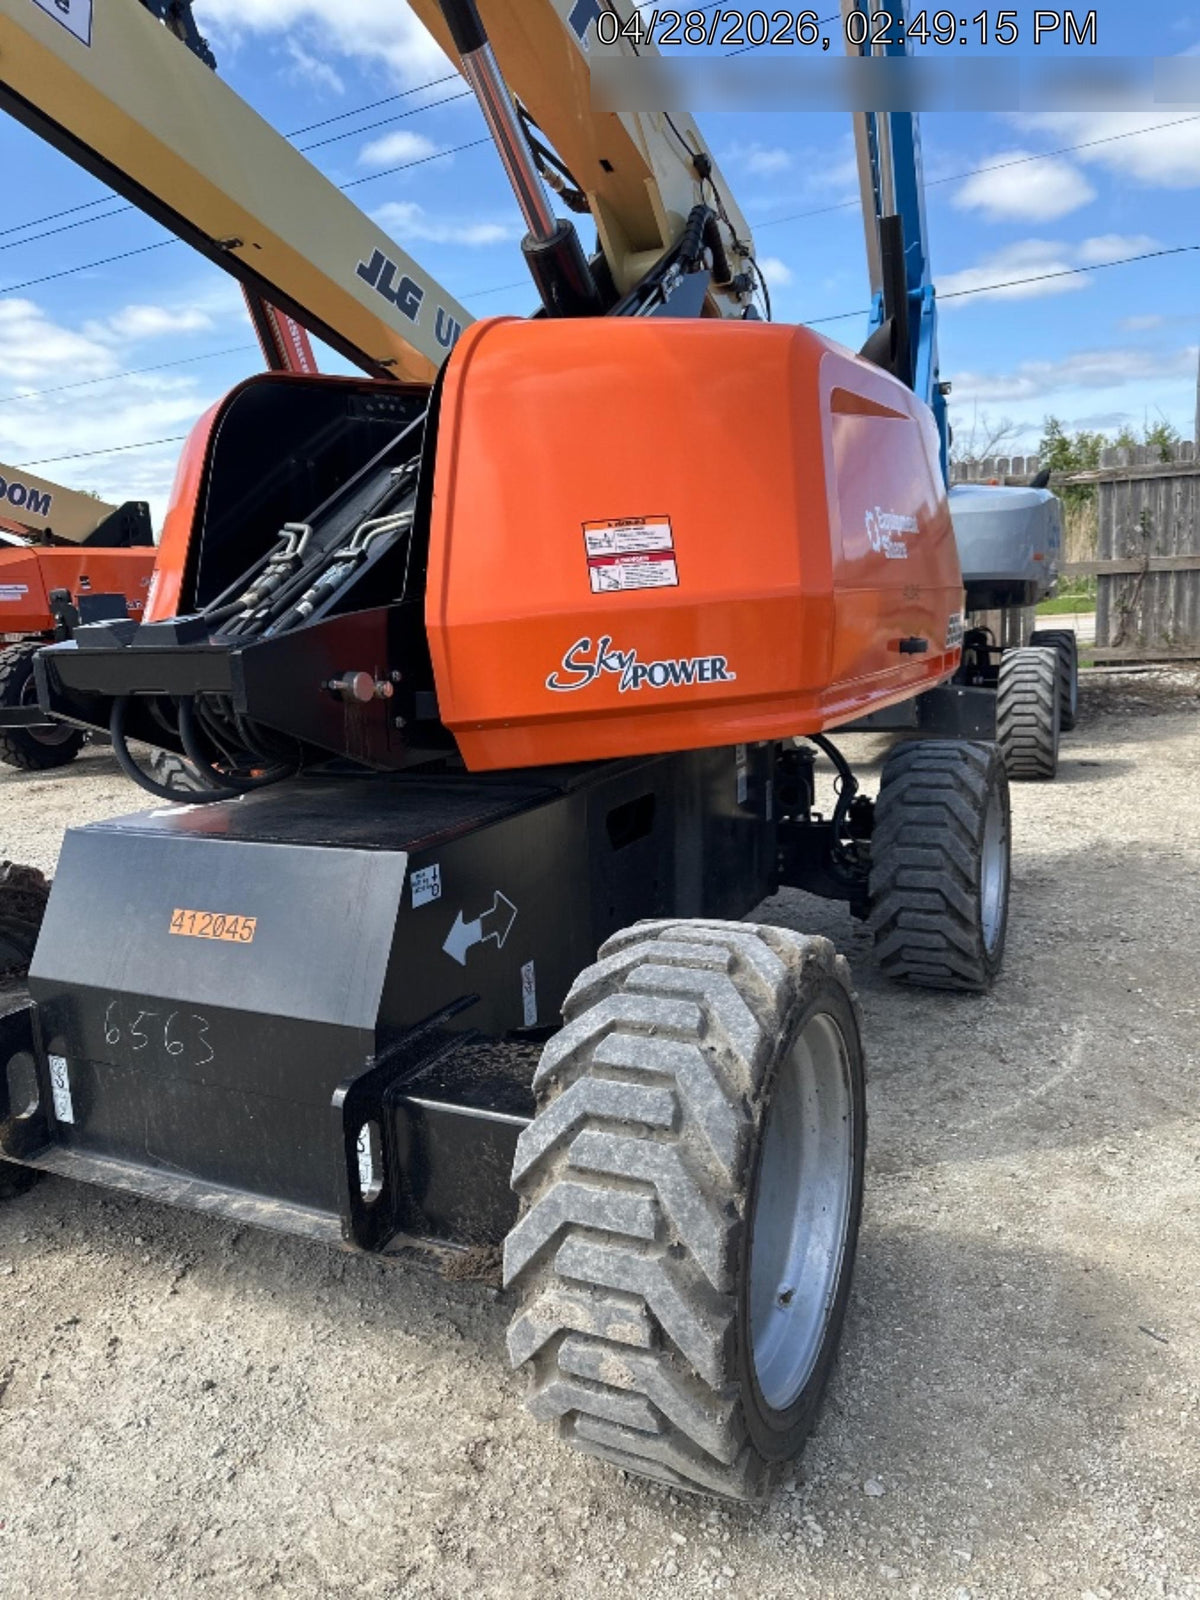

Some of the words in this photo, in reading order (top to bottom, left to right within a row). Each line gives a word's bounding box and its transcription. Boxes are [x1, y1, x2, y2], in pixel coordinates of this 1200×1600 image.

[355, 247, 424, 323] JLG
[171, 911, 255, 941] 412045
[104, 1000, 214, 1066] 6563
